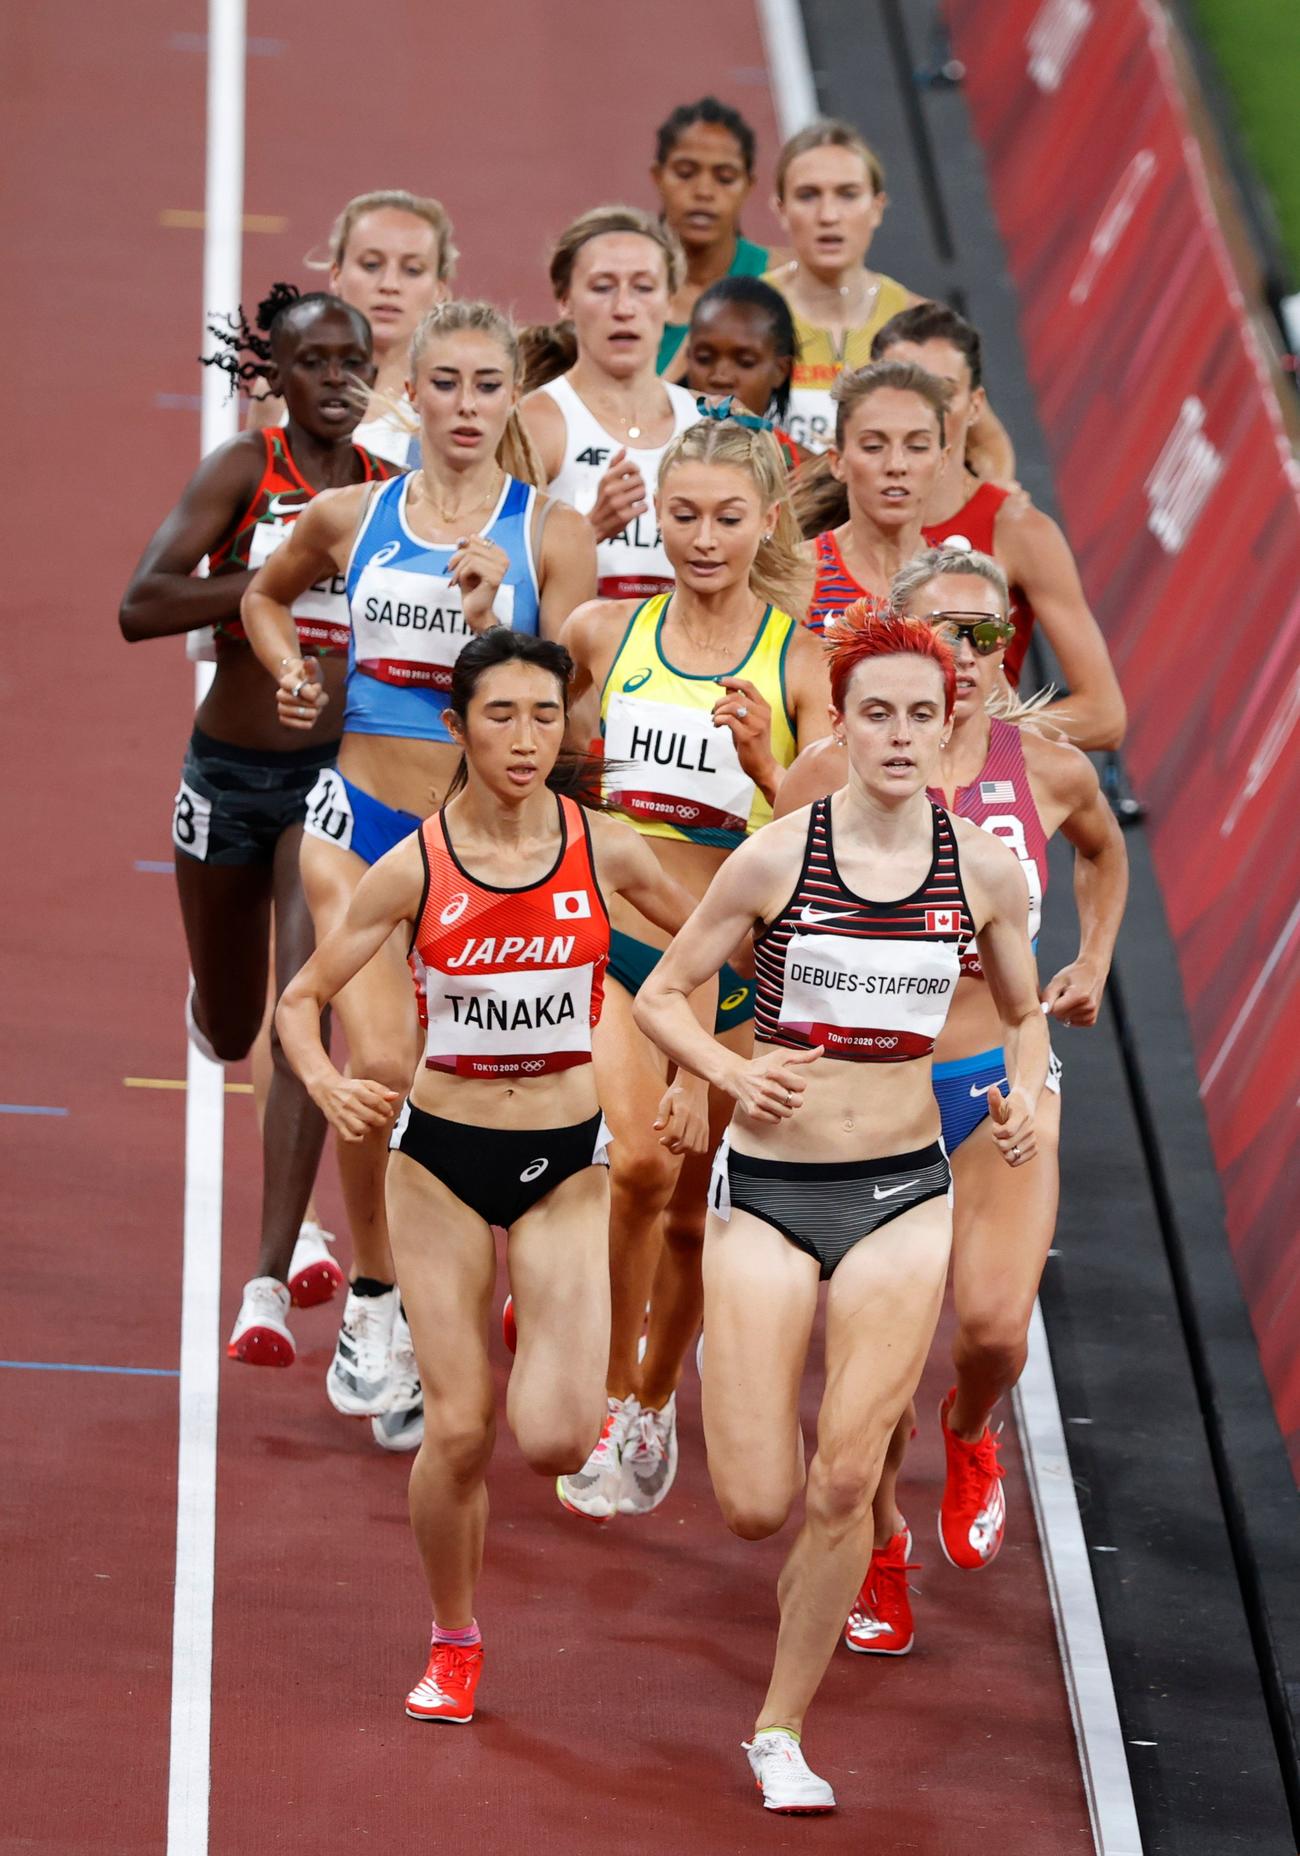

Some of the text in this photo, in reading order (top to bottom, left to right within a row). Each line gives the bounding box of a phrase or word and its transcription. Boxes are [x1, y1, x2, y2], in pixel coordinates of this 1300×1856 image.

[364, 597, 474, 636] SABBATI
[388, 665, 411, 678] TOKYO
[630, 725, 716, 773] HULL
[631, 798, 675, 813] TOKYO 2020
[446, 935, 576, 968] JAPAN
[790, 963, 951, 995] DEBUES-STAFFORD
[444, 991, 575, 1031] TANAKA
[827, 1032, 873, 1046] TOKYO 2020
[472, 1062, 519, 1072] TOKYO 2020
